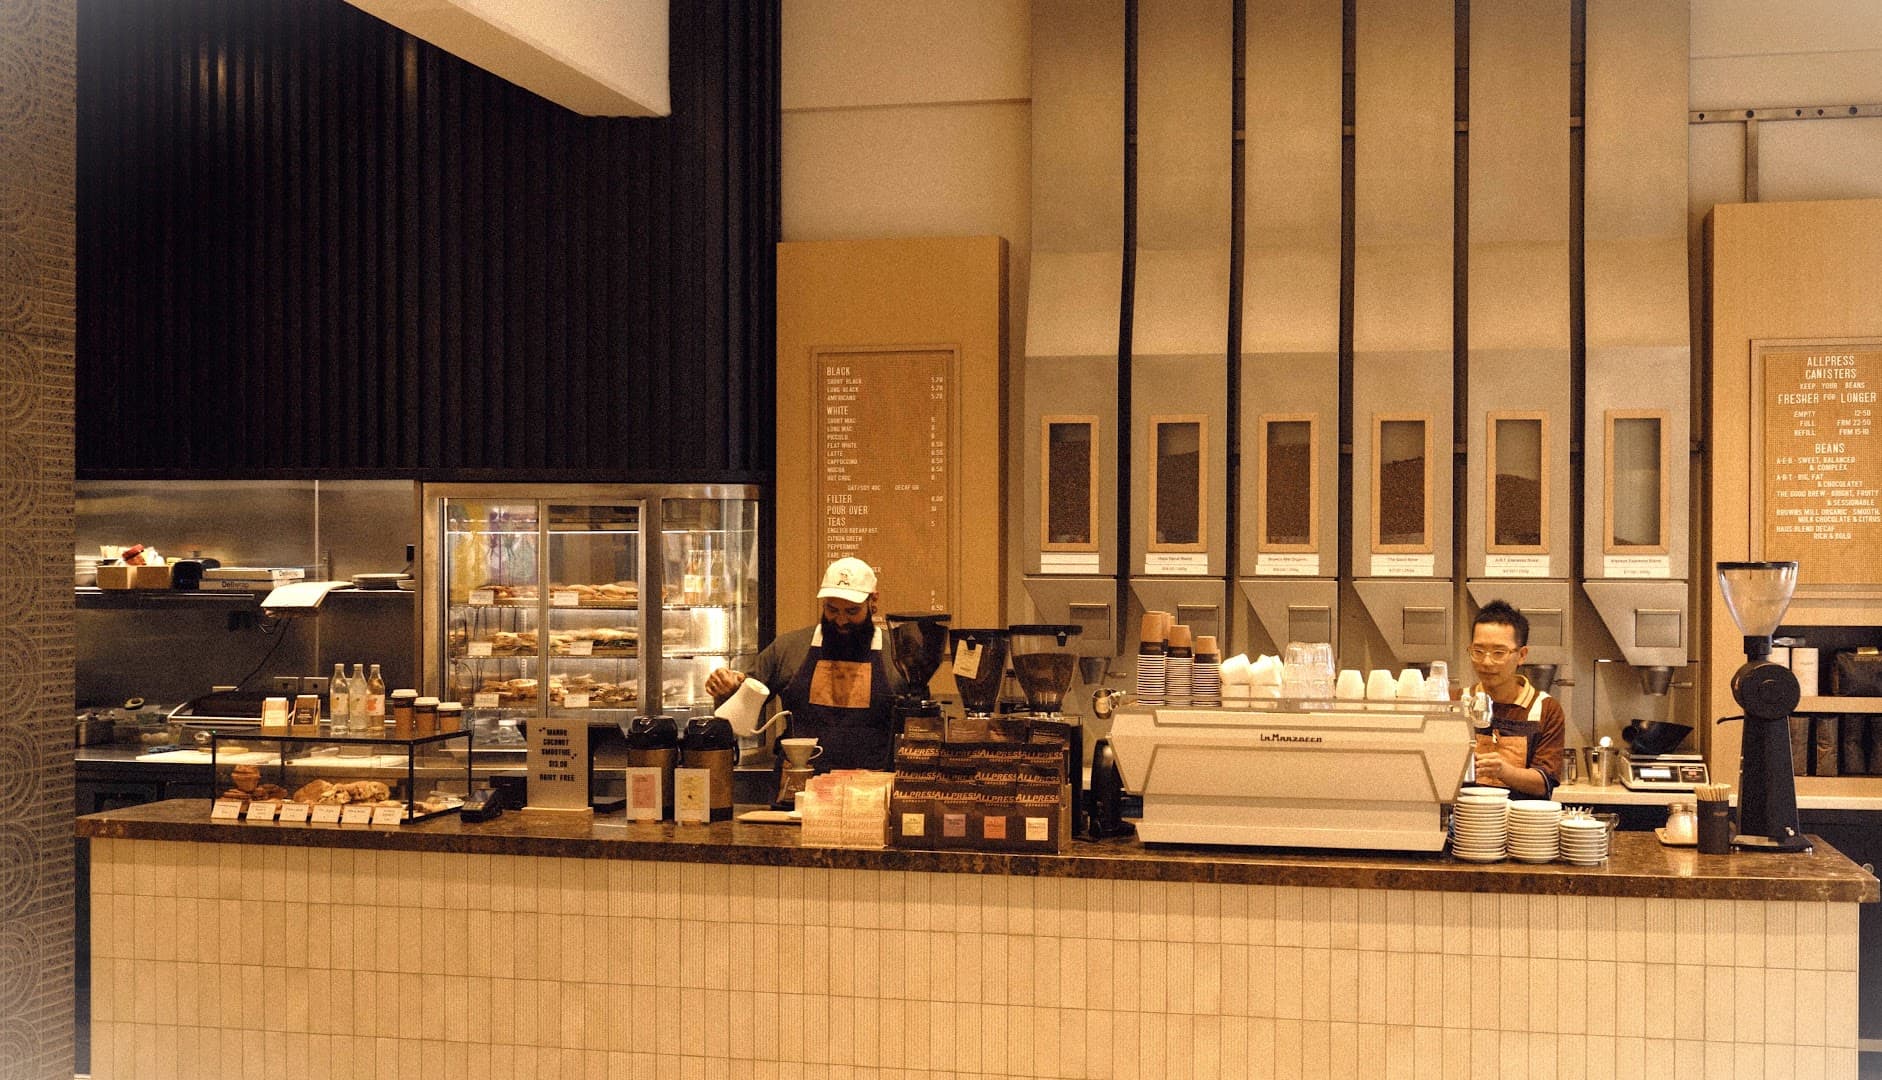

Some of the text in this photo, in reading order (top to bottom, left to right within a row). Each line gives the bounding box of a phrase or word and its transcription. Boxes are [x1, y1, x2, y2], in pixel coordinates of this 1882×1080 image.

[1807, 356, 1855, 367] ALLPRESS
[826, 367, 850, 376] BLACK
[1805, 368, 1857, 379] CANISTERS
[1778, 393, 1819, 404] FRESHER
[1840, 392, 1877, 403] LONGER
[827, 406, 848, 415] WHITE
[1815, 443, 1845, 454] BEANS
[826, 494, 852, 504] FILTER
[826, 505, 846, 515] POUR
[849, 505, 869, 515] OVER
[827, 517, 846, 527] TEAS
[541, 748, 571, 756] SMOOTHIE
[898, 746, 939, 756] ALLPRESS
[559, 774, 576, 782] FREE
[975, 772, 1016, 781] ALLPRESS
[893, 790, 936, 799] ALLPRESS
[935, 791, 977, 800] ALLPRESS
[1016, 794, 1060, 803] ALLPRESS
